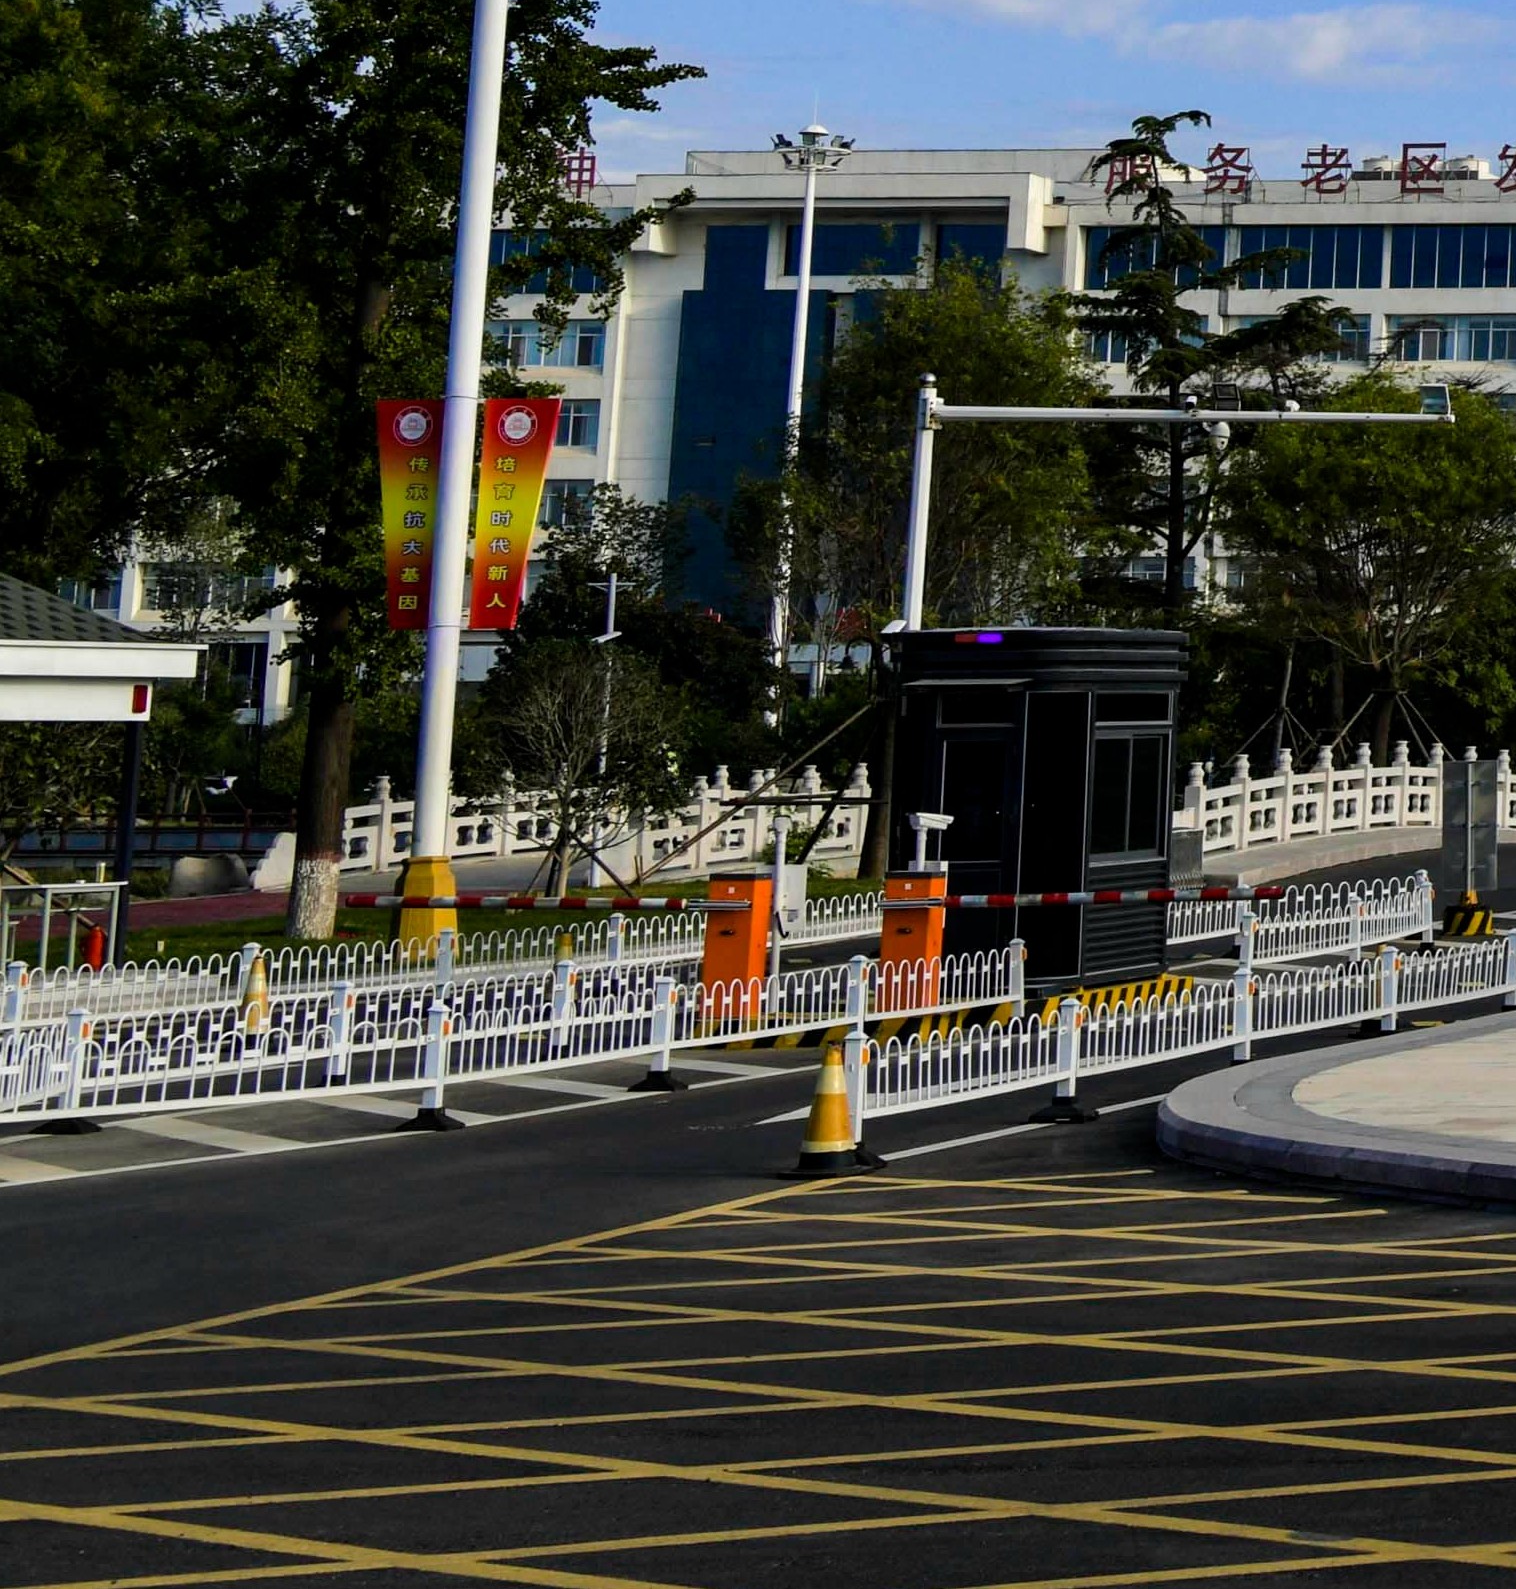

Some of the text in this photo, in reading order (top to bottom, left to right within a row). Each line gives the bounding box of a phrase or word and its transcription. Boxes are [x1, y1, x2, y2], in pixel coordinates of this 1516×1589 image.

[398, 456, 429, 610] 传承抗大基因
[485, 456, 517, 609] 培育时代新人
